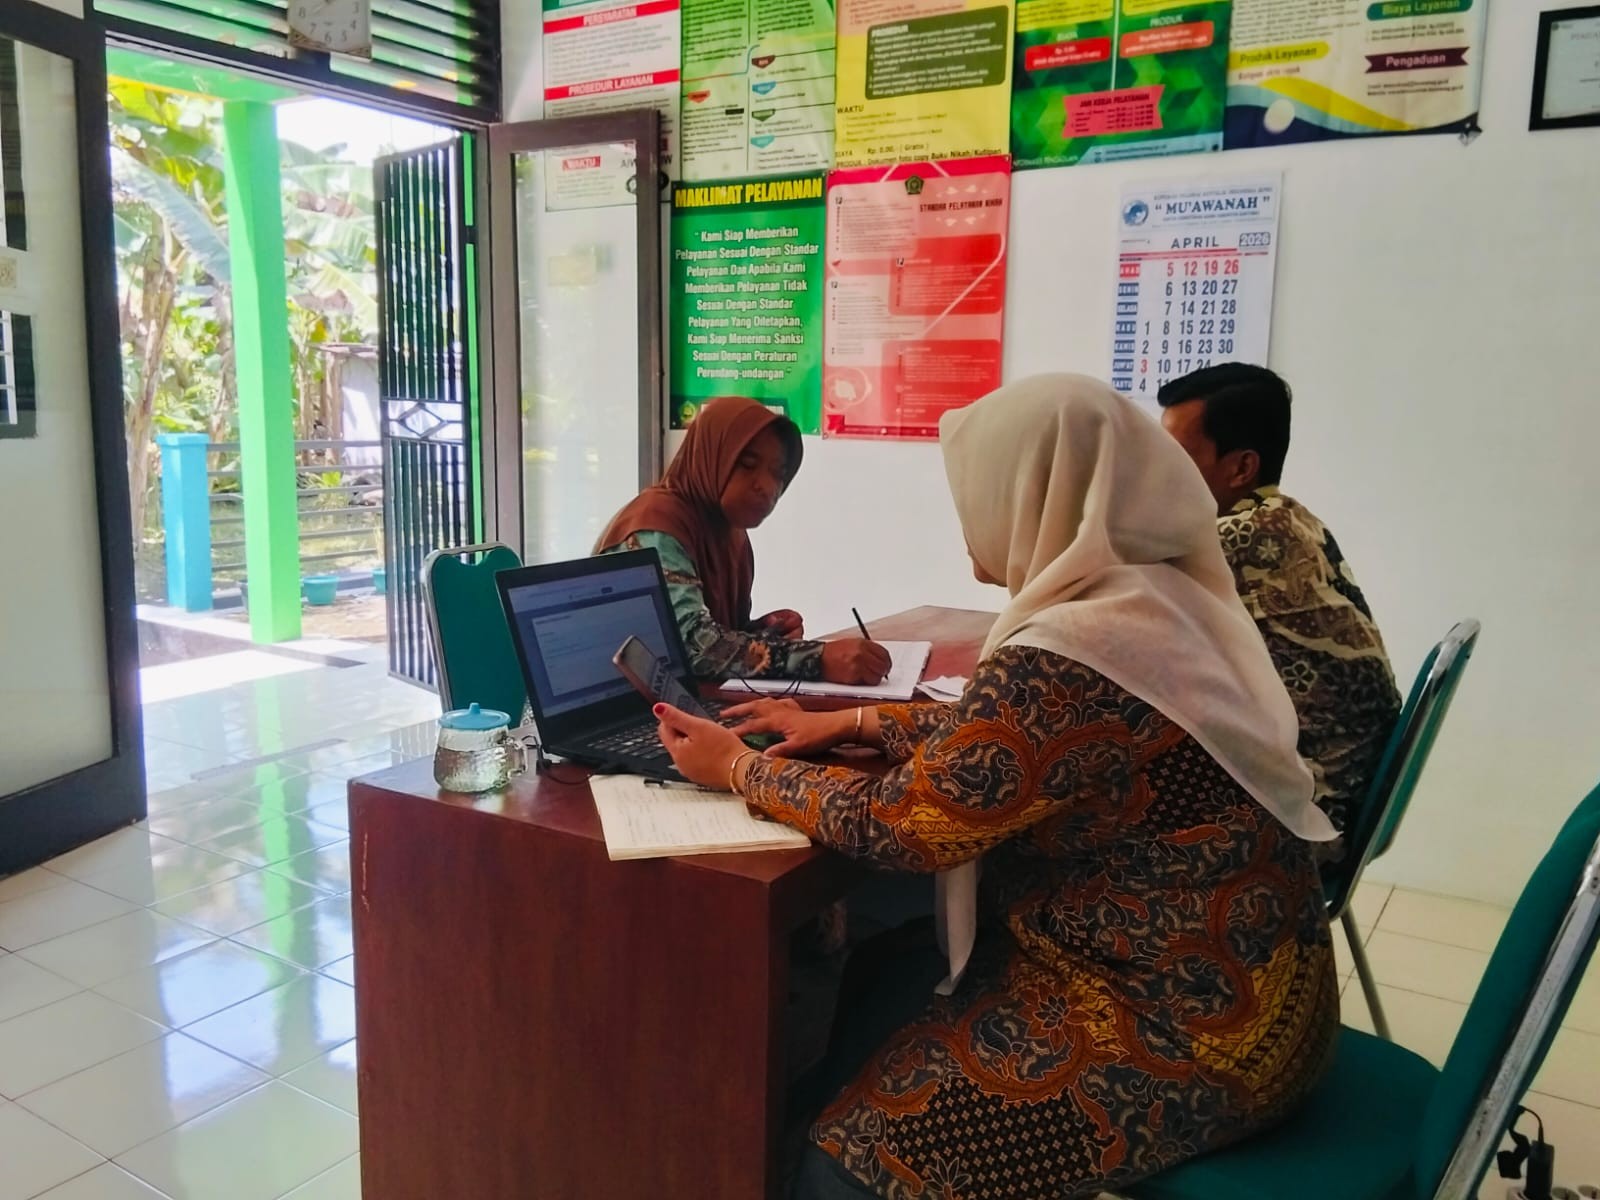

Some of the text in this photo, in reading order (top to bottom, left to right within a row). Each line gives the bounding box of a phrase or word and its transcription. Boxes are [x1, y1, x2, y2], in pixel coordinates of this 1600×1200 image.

[1276, 48, 1318, 61] Layanan
[1385, 54, 1446, 68] Pengaduan
[568, 73, 654, 96] PROSEDUR LAYANAN
[837, 105, 864, 114] WAKTU
[675, 178, 822, 208] MAKLIMAT PELAYANAN
[1166, 196, 1258, 215] MU'AWANAH
[702, 231, 722, 242] Kami
[724, 230, 743, 242] Siap
[746, 226, 798, 240] Memberikan
[1171, 232, 1270, 248] APRIL 2026
[676, 244, 819, 262] Pelayanan Sesuai Dengan Standar
[686, 262, 806, 278] Pelayanan Dan Apabila Kami
[1167, 262, 1174, 277] 5
[1184, 261, 1198, 276] 12
[1204, 260, 1218, 276] 19
[1224, 259, 1239, 275] 26
[685, 280, 807, 294] Memberikan Pelayanan Tidak
[1166, 282, 1173, 296] 6
[1182, 281, 1197, 296] 13
[1201, 280, 1218, 295] 20
[1222, 280, 1238, 294] 27
[697, 298, 793, 312] Sesuai Dengan Standar
[1165, 301, 1172, 316] 7
[1181, 301, 1195, 315] 14
[1201, 300, 1215, 315] 21
[1221, 300, 1236, 314] 28
[688, 317, 729, 329] Pelayanan
[731, 316, 751, 328] Yang
[1145, 321, 1150, 335] 1
[1163, 321, 1170, 335] 8
[1180, 320, 1194, 335] 15
[1199, 320, 1214, 334] 22
[1220, 319, 1235, 334] 29
[688, 333, 804, 346] Kami Siap Menerima Sanksi
[1142, 340, 1149, 354] 2
[1162, 340, 1169, 354] 9
[1178, 340, 1192, 354] 16
[1198, 340, 1212, 354] 23
[1218, 339, 1233, 354] 30
[692, 350, 798, 363] Sesuai Dengan Peraturan
[1141, 359, 1147, 373] 3
[1158, 359, 1171, 373] 10
[1178, 359, 1191, 373] 17
[1197, 359, 1211, 369] 24
[1139, 378, 1146, 392] 4
